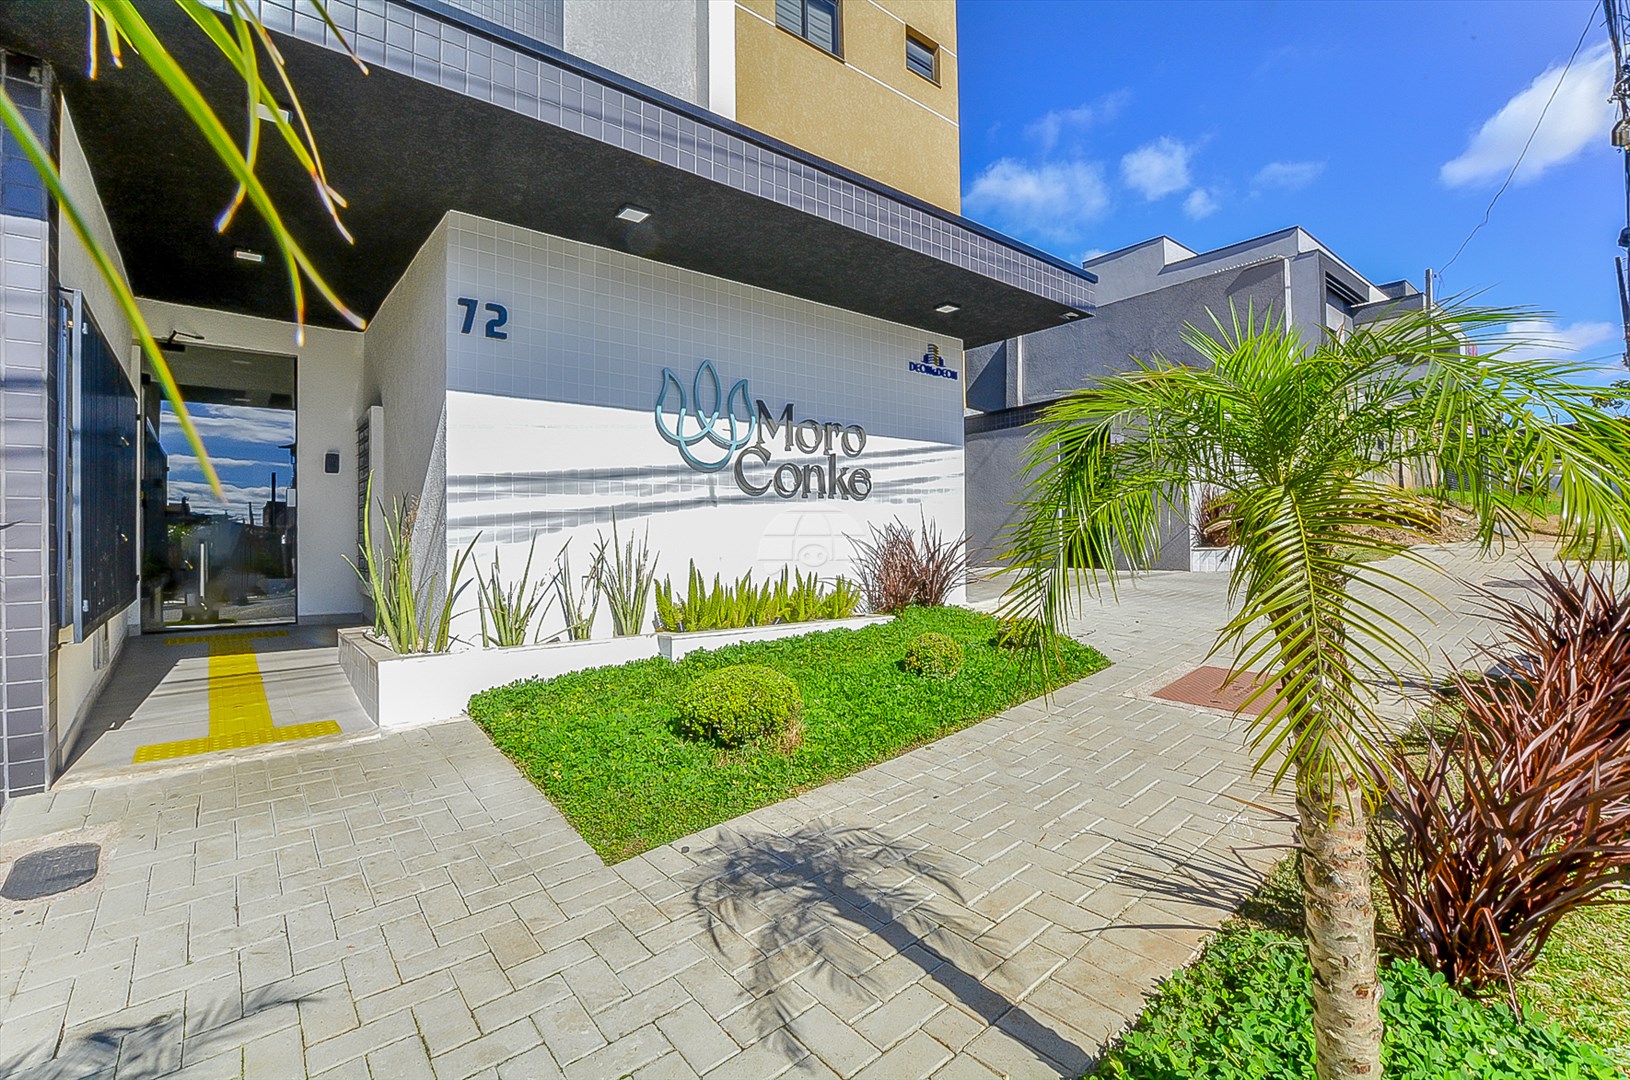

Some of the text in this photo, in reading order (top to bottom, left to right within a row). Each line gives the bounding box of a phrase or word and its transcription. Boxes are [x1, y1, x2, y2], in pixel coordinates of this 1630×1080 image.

[457, 297, 508, 340] 72
[756, 399, 867, 458] Moro
[734, 445, 872, 501] Conke
